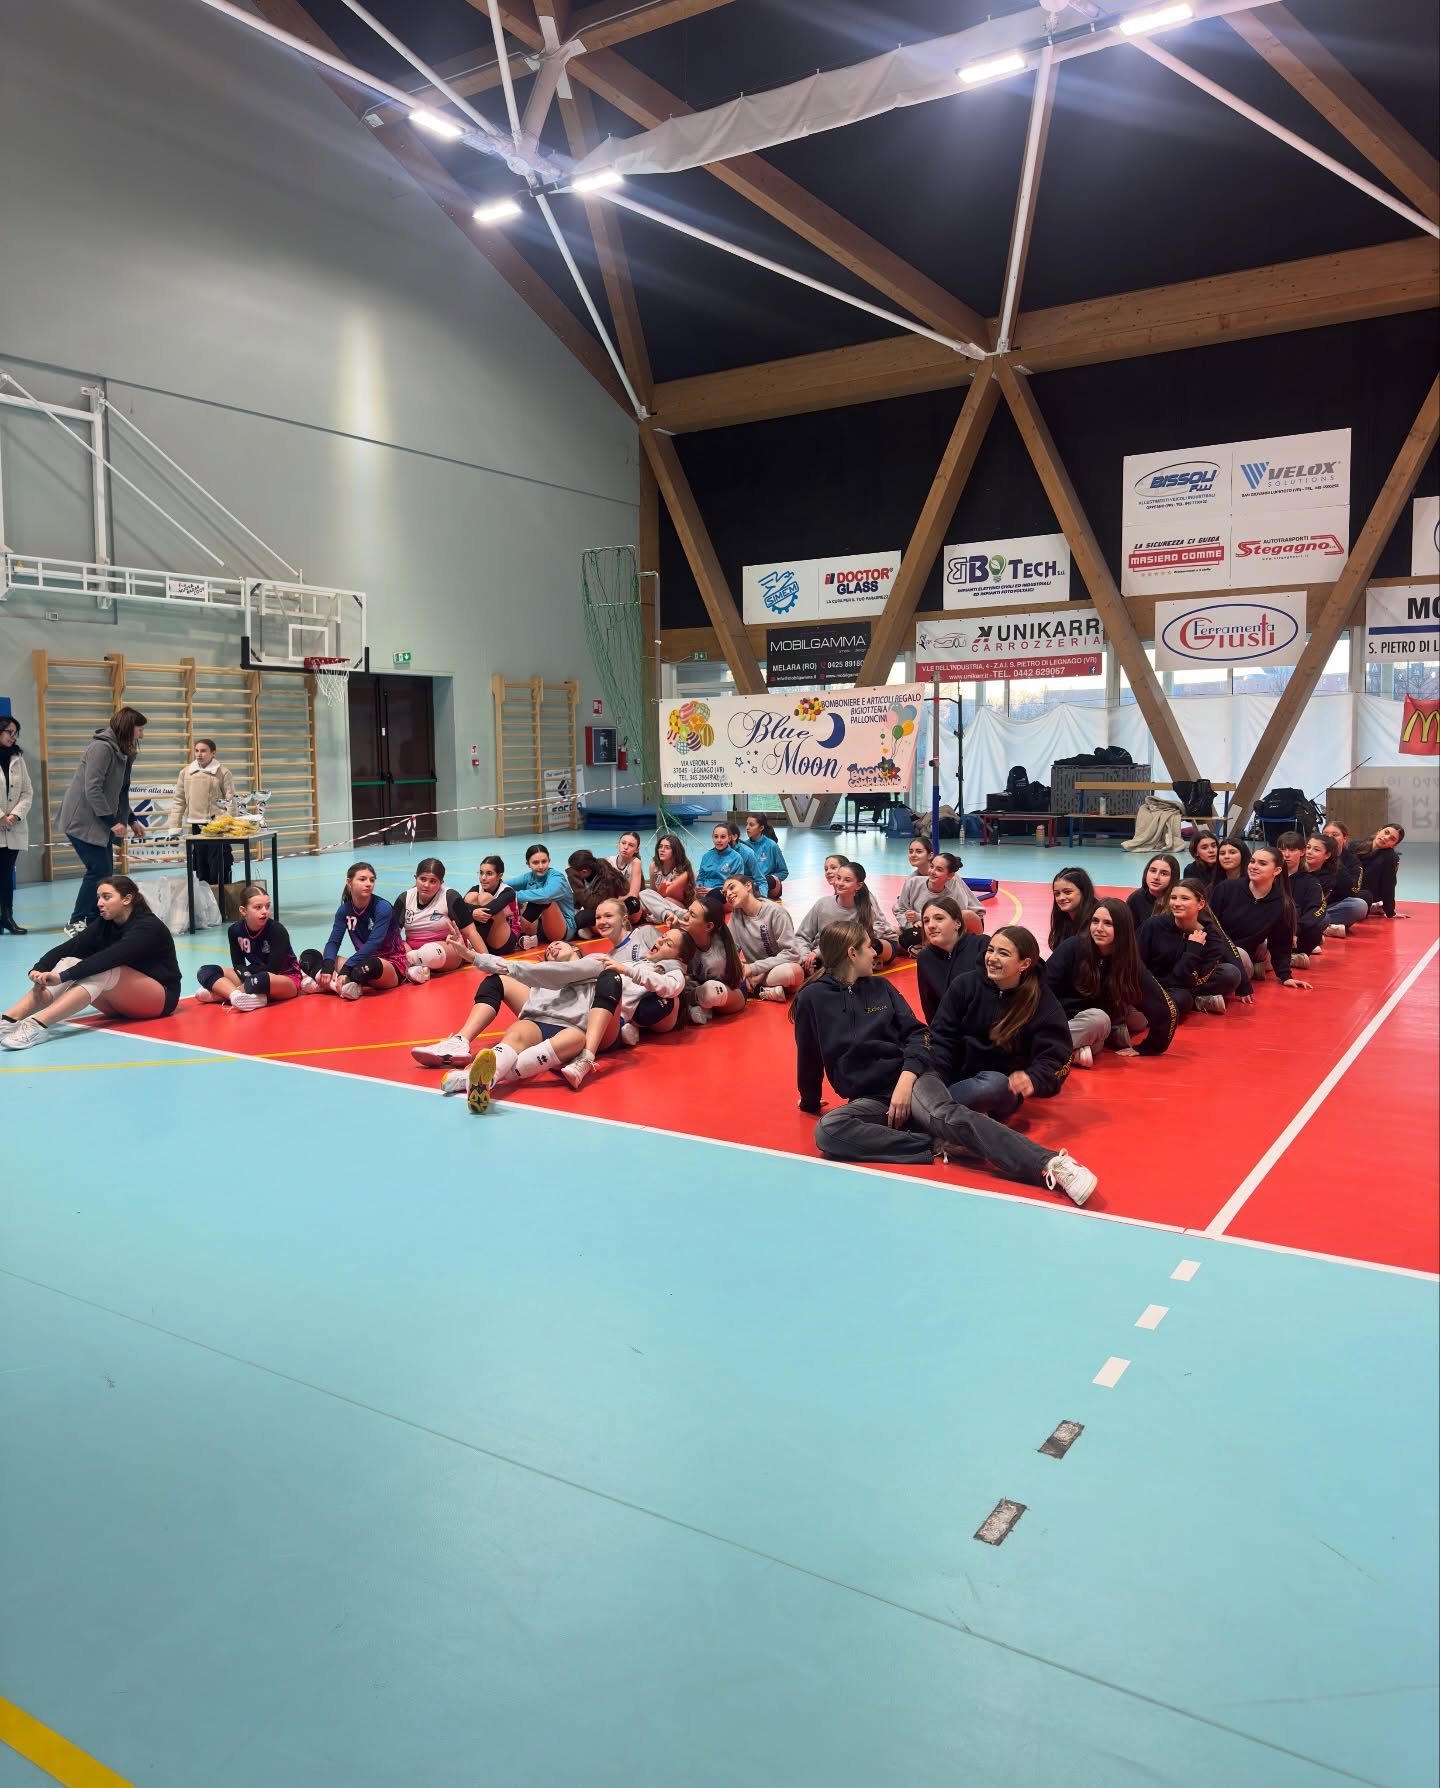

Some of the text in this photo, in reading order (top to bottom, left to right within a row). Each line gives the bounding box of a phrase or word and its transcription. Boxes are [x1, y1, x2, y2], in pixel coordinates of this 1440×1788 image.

[1269, 461, 1337, 480] VELOX
[1267, 474, 1335, 487] SOLUTIONS
[1145, 539, 1185, 548] SICUREZZA
[1263, 535, 1309, 544] AUTOTRASPORTI
[1235, 540, 1330, 557] Stegagno
[1130, 550, 1222, 565] MASIERO GOMME
[837, 568, 890, 583] DOCTOR
[766, 583, 798, 607] SIMEM
[837, 581, 879, 595] GLASS
[997, 618, 1100, 642] UNIKARR
[1180, 613, 1275, 650] Giusti
[1194, 616, 1275, 635] Ferramenta
[770, 635, 866, 652] MOBILGAMMA
[971, 636, 1100, 653] CARROZZERIA
[1369, 642, 1377, 654] S.
[1381, 641, 1416, 654] PIETRO
[1419, 640, 1430, 652] DI
[802, 662, 817, 671] (RO)
[827, 661, 844, 669] 0425
[1049, 658, 1082, 666] LEGNAGO
[992, 670, 1011, 679] TEL.
[1013, 669, 1034, 677] 0442
[821, 693, 922, 708] BOMBONIERE E ARTICOLI REGALO
[850, 705, 888, 715] BIGIOTTERIA
[850, 714, 888, 724] PALLONCINI
[727, 709, 813, 748] Blue
[762, 736, 843, 779] Moon
